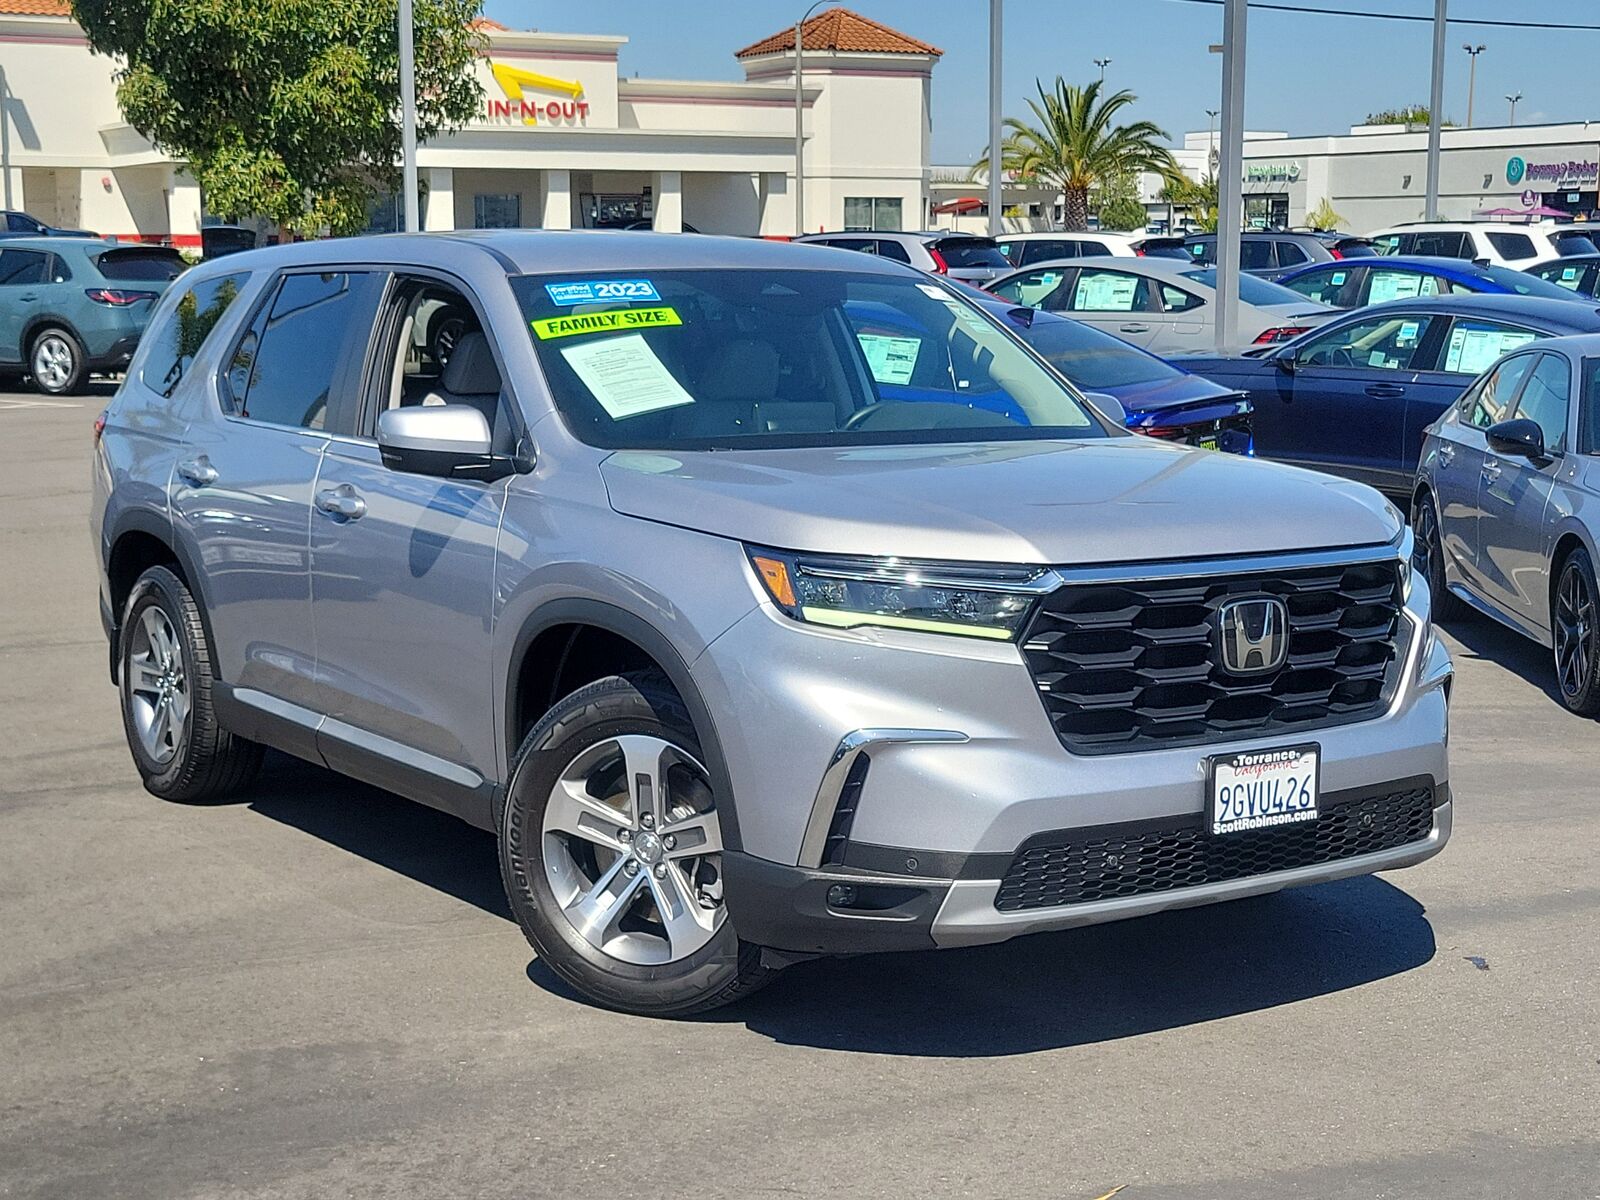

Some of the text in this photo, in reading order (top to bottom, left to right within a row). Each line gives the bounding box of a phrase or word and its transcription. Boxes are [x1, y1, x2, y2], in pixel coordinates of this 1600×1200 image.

[487, 99, 589, 120] IN-N-OUT
[594, 281, 653, 297] 2023
[546, 310, 666, 333] FAMILY SIZE
[1237, 750, 1296, 766] Torrance
[1219, 774, 1312, 822] 9GVU426
[1213, 810, 1318, 835] ScottRobinson.com
